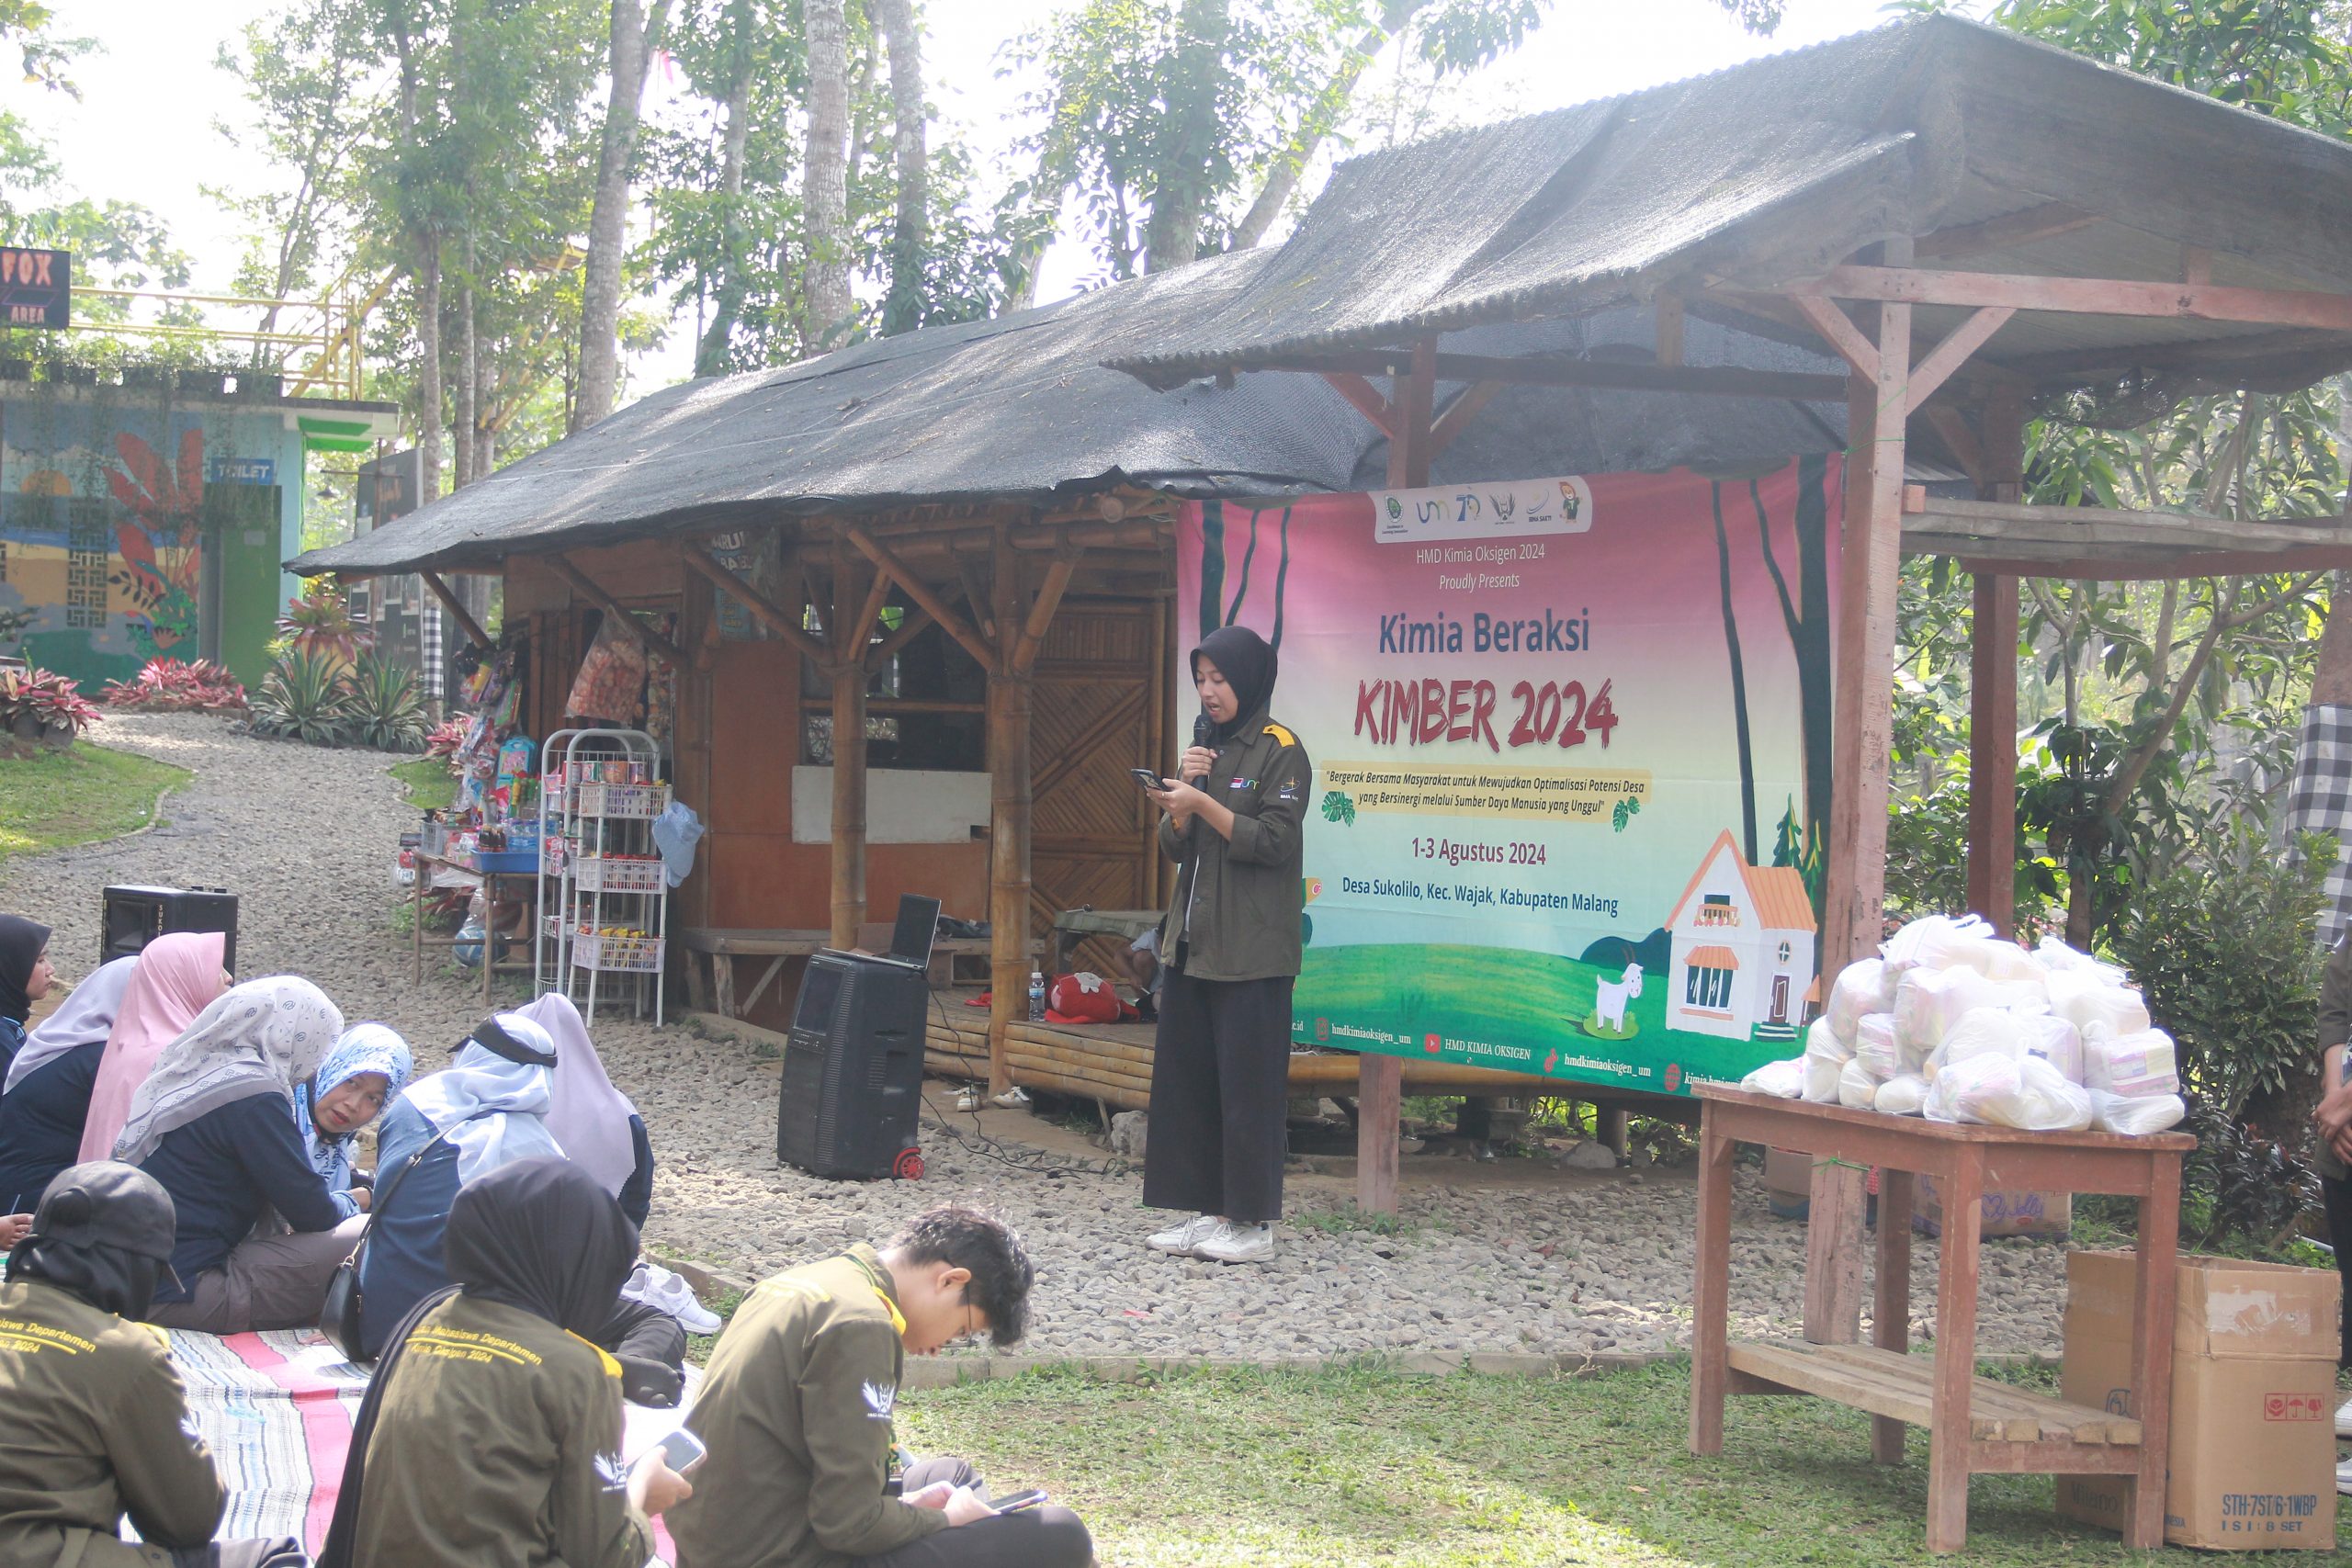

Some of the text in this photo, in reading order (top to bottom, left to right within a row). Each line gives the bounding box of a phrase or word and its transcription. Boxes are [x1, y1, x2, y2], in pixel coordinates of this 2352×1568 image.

[2, 251, 52, 287] FOX
[11, 306, 44, 323] AREA
[1417, 544, 1545, 565] HMD Kimia Oksigen 2024
[1439, 572, 1521, 592] Proudly Presents
[1379, 607, 1589, 653] Kimia Beraksi
[1354, 678, 1619, 753] KIMBER 2024
[1326, 771, 1645, 793] "Bergerak Bersama Masyarakat untuk Mewujudkan Optimalisasi Potensi Desa
[1358, 792, 1605, 816] yang Bersinergi melalui Sumber Daya Manusia yang Unggul"
[1411, 837, 1546, 866] 1-3 Agustus 2024
[1342, 876, 1619, 918] Desa Sukolilo, Kec. Wajak, Kabupaten Malang
[1331, 1023, 1411, 1044] hmdkimiaoksigen_um
[1444, 1038, 1531, 1060] HMD KIMIA OKSIGEN
[1565, 1054, 1651, 1077] hmdkimiaoksigen_um
[11, 1340, 40, 1354] 2024
[26, 1322, 96, 1353] Departemen
[467, 1349, 492, 1363] 2024
[481, 1333, 542, 1365] Departemen
[2280, 1521, 2303, 1531] SET
